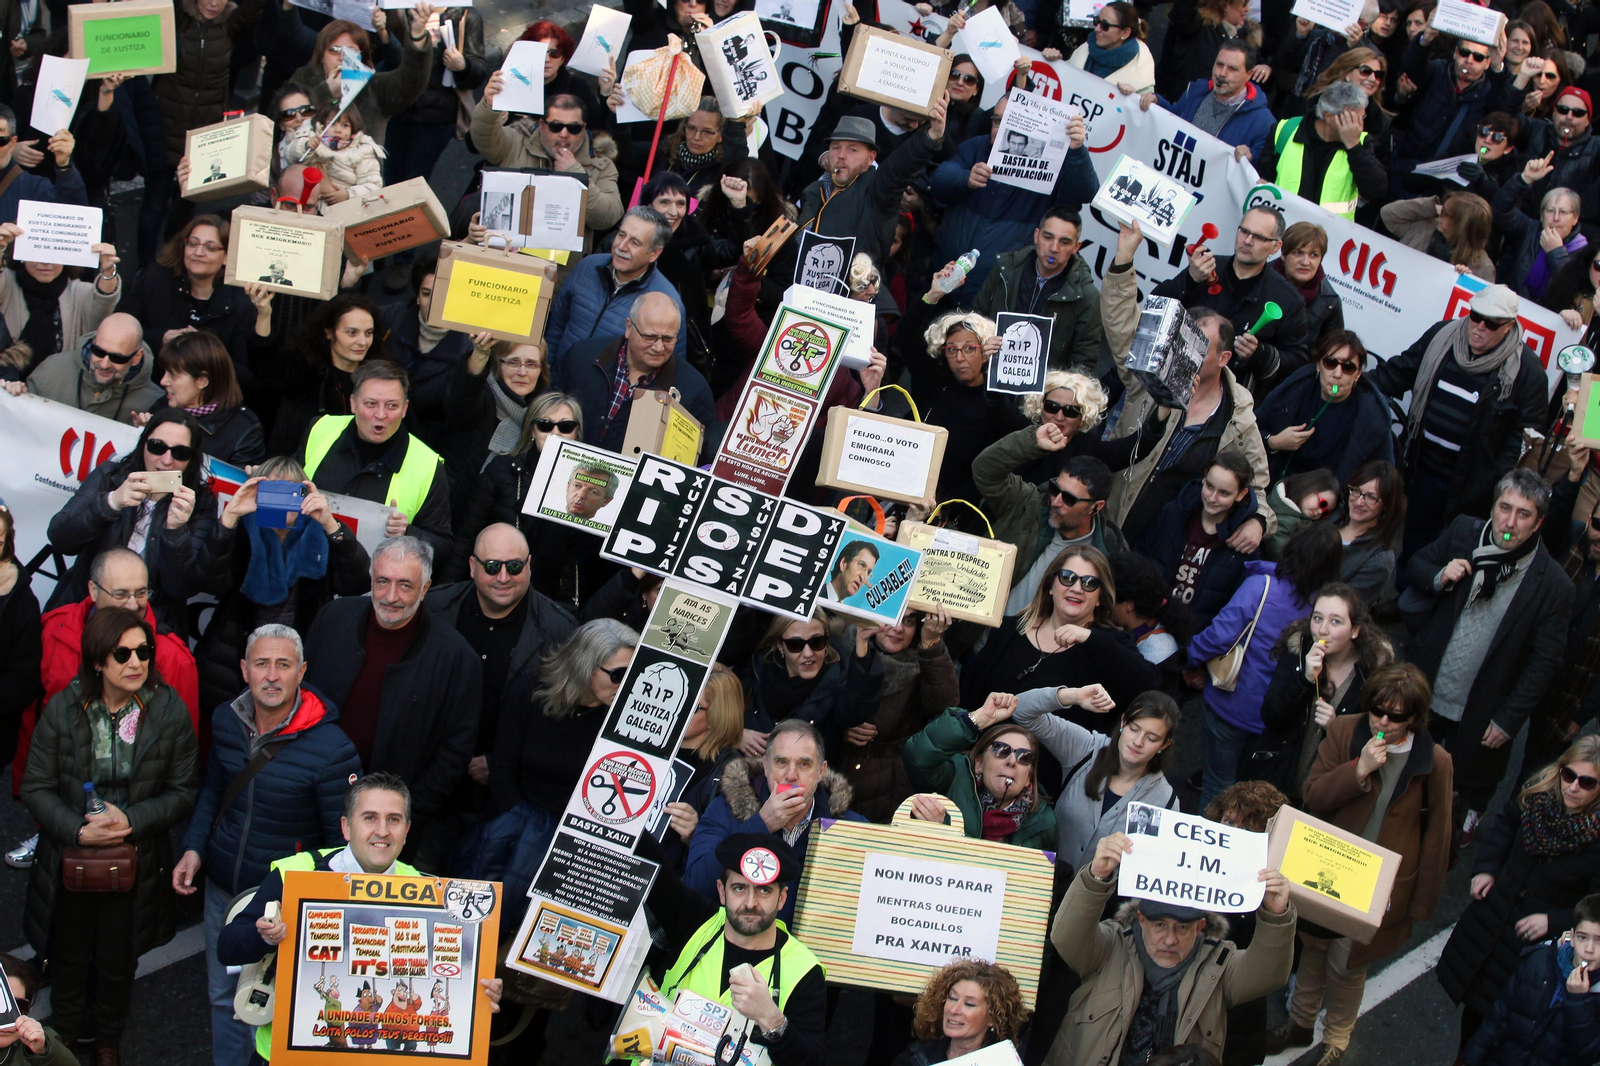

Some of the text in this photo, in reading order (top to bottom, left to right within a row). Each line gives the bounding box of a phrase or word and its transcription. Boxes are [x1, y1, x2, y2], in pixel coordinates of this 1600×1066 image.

[95, 31, 151, 42] FUNCIONARIO
[114, 44, 146, 53] XUSTIZA
[880, 49, 899, 58] XUNTA
[907, 56, 930, 68] ATOPOU
[889, 62, 916, 74] SOLUCIÓN
[892, 72, 904, 81] QUE
[882, 80, 918, 95] EMIGRACIÓN
[1002, 155, 1050, 170] BASTA XA DE
[37, 213, 76, 221] FUNCIONARIO
[51, 230, 89, 238] COMUNIDADE
[353, 216, 415, 238] FUNCIONARIO
[41, 237, 90, 245] RECOMENDACIÓN
[374, 234, 413, 248] XUSTIZA
[811, 257, 835, 270] RIP
[1339, 238, 1398, 298] CIG
[806, 269, 835, 280] XUSTIZA
[468, 279, 529, 295] FUNCIONARIO
[805, 279, 830, 290] GALEGA
[470, 291, 522, 306] DE XUSTIZA
[812, 300, 848, 313] FUNCIONARIO
[1342, 296, 1364, 311] XUSTIZA
[1354, 286, 1402, 313] Intersindical Galega
[804, 306, 827, 315] XUSTIZA
[827, 311, 858, 324] EMIGRANDO
[790, 341, 820, 361] 7-F
[1007, 340, 1032, 352] RIP
[1003, 354, 1034, 366] XUSTIZA
[1002, 366, 1031, 377] GALEGA
[762, 374, 813, 396] FOLGA INDEFINIDA
[851, 441, 895, 457] EMIGRARÁ
[896, 438, 919, 449] VOTO
[727, 458, 740, 467] ESTO
[741, 463, 753, 471] NON
[848, 454, 892, 468] CONNOSCO
[576, 474, 607, 487] MENTIREIRO
[611, 458, 686, 557] RIP
[543, 508, 584, 525] XUSTIZA EN
[658, 475, 706, 570] XUSTIZA
[684, 486, 753, 585] SOS
[726, 498, 774, 594] XUSTIZA
[750, 503, 822, 601] DEP
[794, 520, 841, 615] XUSTIZA
[956, 551, 990, 570] DESPREZO
[865, 558, 915, 610] CULPABLE!!!
[922, 586, 977, 604] Folga indefinida
[683, 598, 712, 614] ATA AS
[942, 598, 969, 609] febreiro
[673, 607, 709, 626] NARICES
[642, 681, 674, 703] RIP
[630, 699, 671, 722] XUSTIZA
[626, 715, 663, 736] GALEGA
[603, 758, 629, 772] NON MAIS
[570, 818, 630, 844] BASTA XA!!!
[1174, 822, 1231, 850] CESE
[574, 838, 586, 847] NON
[552, 847, 649, 885] MESMO TRABALLO, IGUAL SALARIO!!!
[553, 856, 565, 865] NON
[571, 861, 612, 878] PRECARIEDADE
[1177, 851, 1227, 876] J. M.
[568, 869, 579, 878] NON
[874, 868, 993, 894] NON IMOS PARAR
[350, 879, 437, 903] FOLGA
[553, 872, 630, 903] NON MEDIAS VERDADES!!!
[561, 883, 583, 895] XUNTOS
[1135, 874, 1245, 907] BARREIRO
[555, 889, 566, 897] NIN
[576, 895, 591, 905] PASO
[554, 896, 629, 927] RUEDA CULPABLES
[877, 895, 983, 918] MENTRAS QUEDEN
[308, 911, 342, 919] COMPLEMENTO
[309, 920, 340, 930] AUTONÓMICO
[352, 926, 389, 936] DESCONTOS POR
[394, 920, 419, 929] COBRO DO
[891, 916, 963, 934] BOCADILLOS
[310, 932, 340, 940] TRANSITORIO
[352, 937, 386, 947] INCAPACIDADE
[308, 945, 342, 961] CAT
[356, 948, 381, 957] TEMPORAL
[875, 934, 972, 957] PRA XANTAR
[351, 959, 388, 977] IT'S
[392, 958, 429, 967] MESMO TRABALLO
[703, 1002, 729, 1019] SPJ
[317, 1010, 452, 1028] A UNIDADE FAINOS FORTES.
[313, 1024, 399, 1040] LOITA POLOS TEUS
